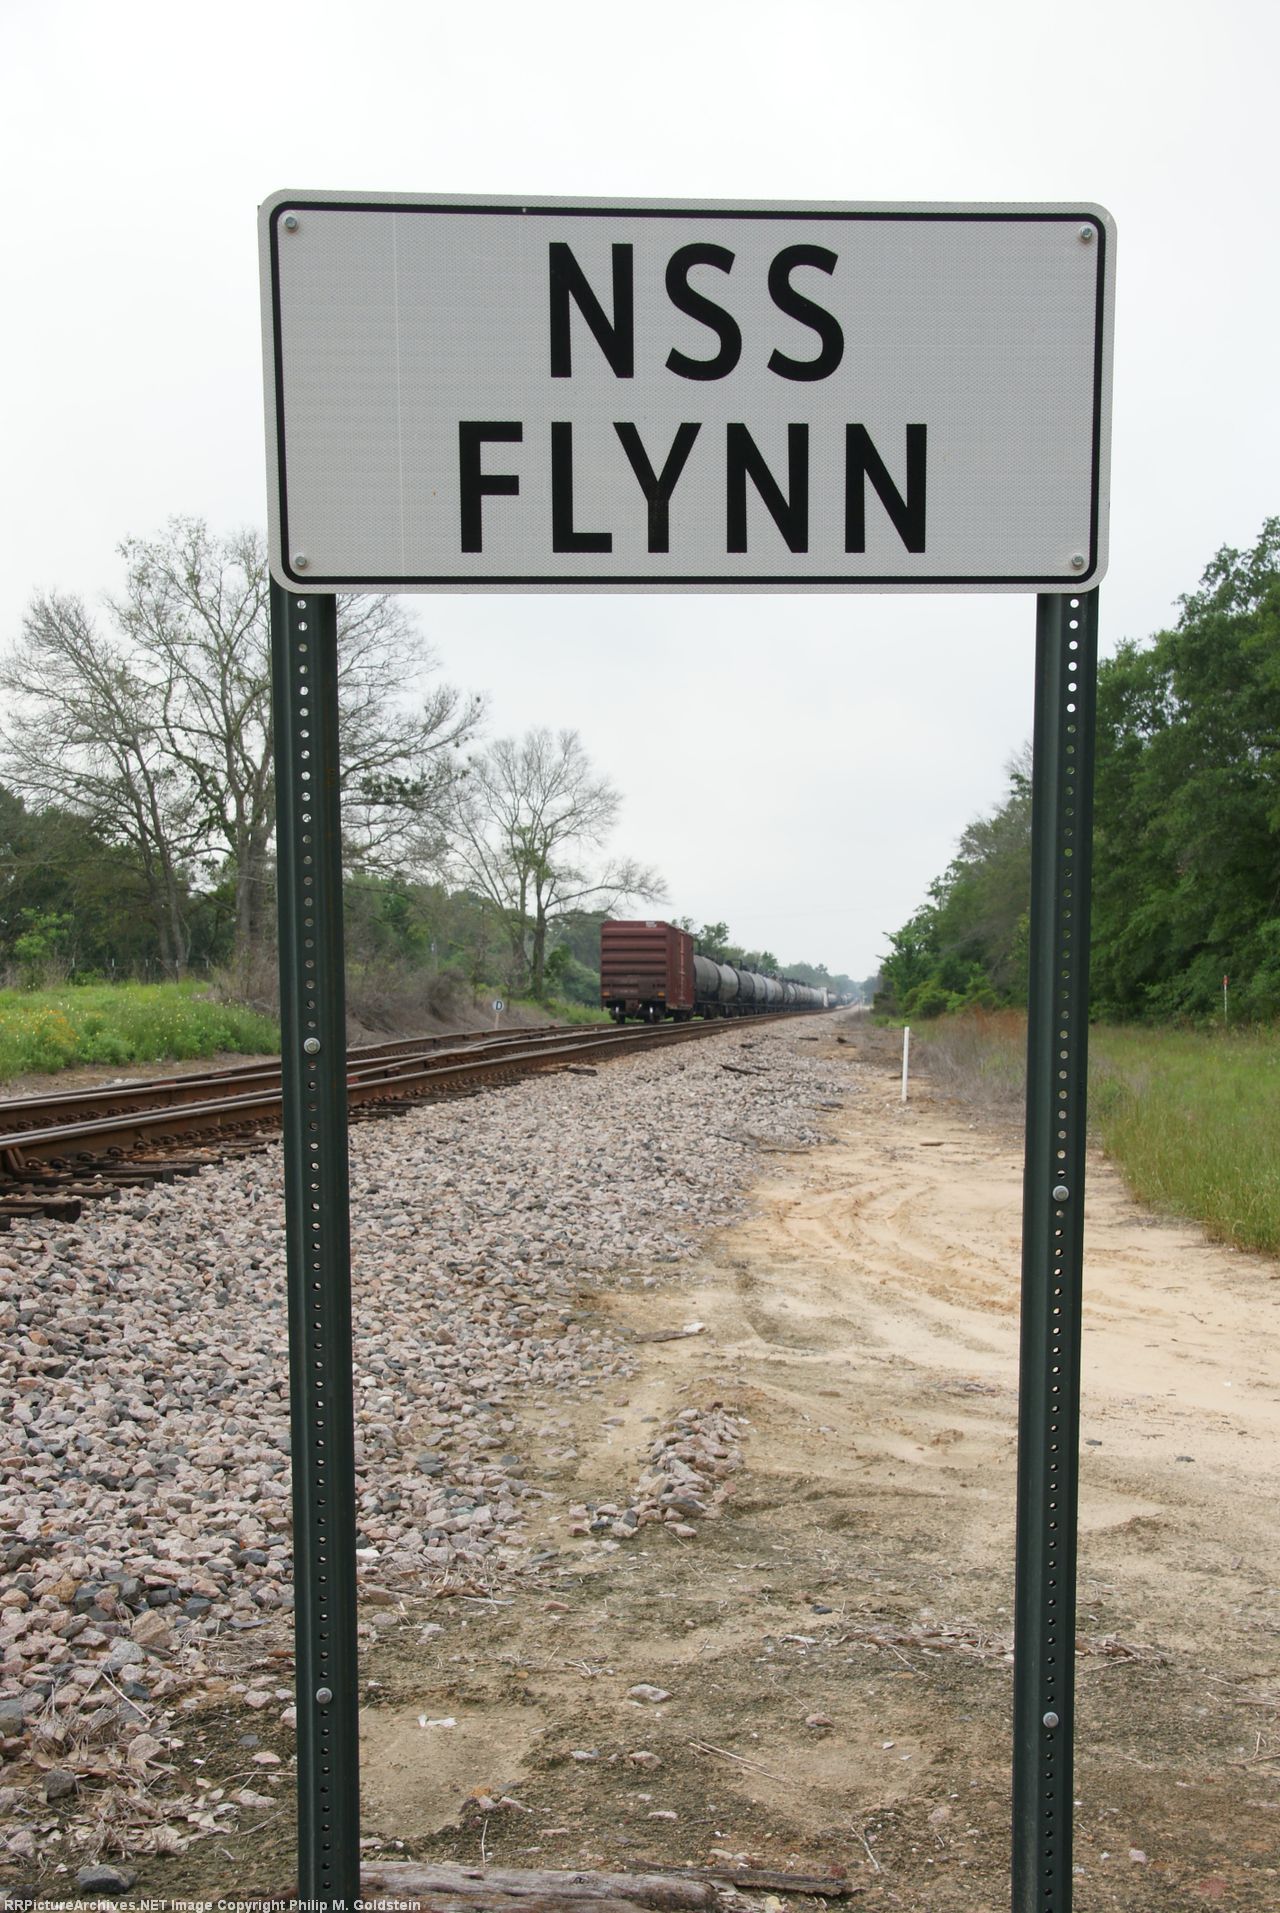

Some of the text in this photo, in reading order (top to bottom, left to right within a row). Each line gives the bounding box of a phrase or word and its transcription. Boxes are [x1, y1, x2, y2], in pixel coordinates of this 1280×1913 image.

[549, 242, 845, 382] NSS
[458, 420, 928, 554] FLYNN
[495, 1000, 503, 1011] D
